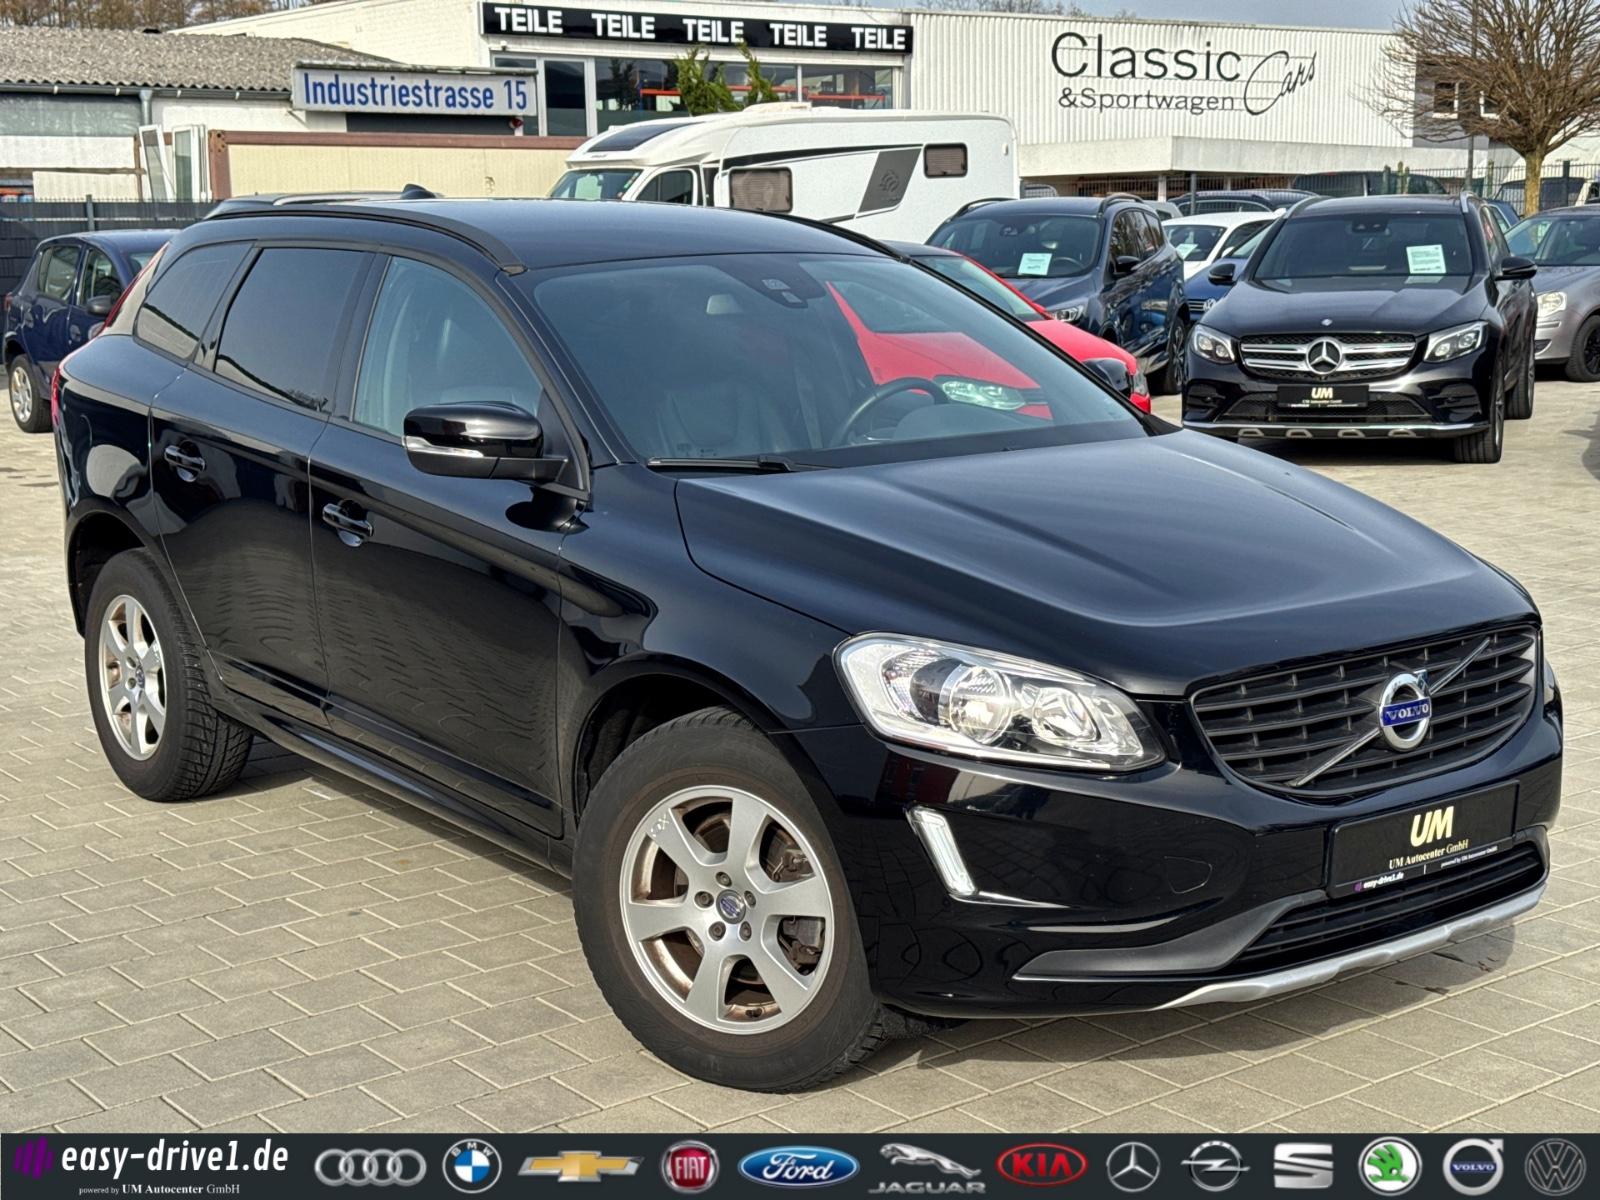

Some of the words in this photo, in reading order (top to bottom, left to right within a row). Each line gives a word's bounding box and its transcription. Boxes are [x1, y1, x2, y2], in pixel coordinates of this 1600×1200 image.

[494, 7, 563, 35] TEILE
[591, 12, 656, 39] TEILE
[682, 18, 745, 43] TEILE
[769, 23, 827, 47] TEILE
[850, 26, 906, 50] TEILE
[1051, 31, 1242, 81] Classic
[1243, 50, 1317, 116] Cars
[303, 72, 494, 109] Industriestrasse
[503, 80, 528, 110] 15
[1058, 87, 1235, 115] &Sportwagen
[1311, 387, 1334, 399] UM
[1386, 703, 1429, 720] VOLVO
[1410, 805, 1455, 847] UM
[1389, 857, 1404, 870] UM
[1404, 848, 1446, 867] Autocenter
[1446, 839, 1469, 854] GmbH
